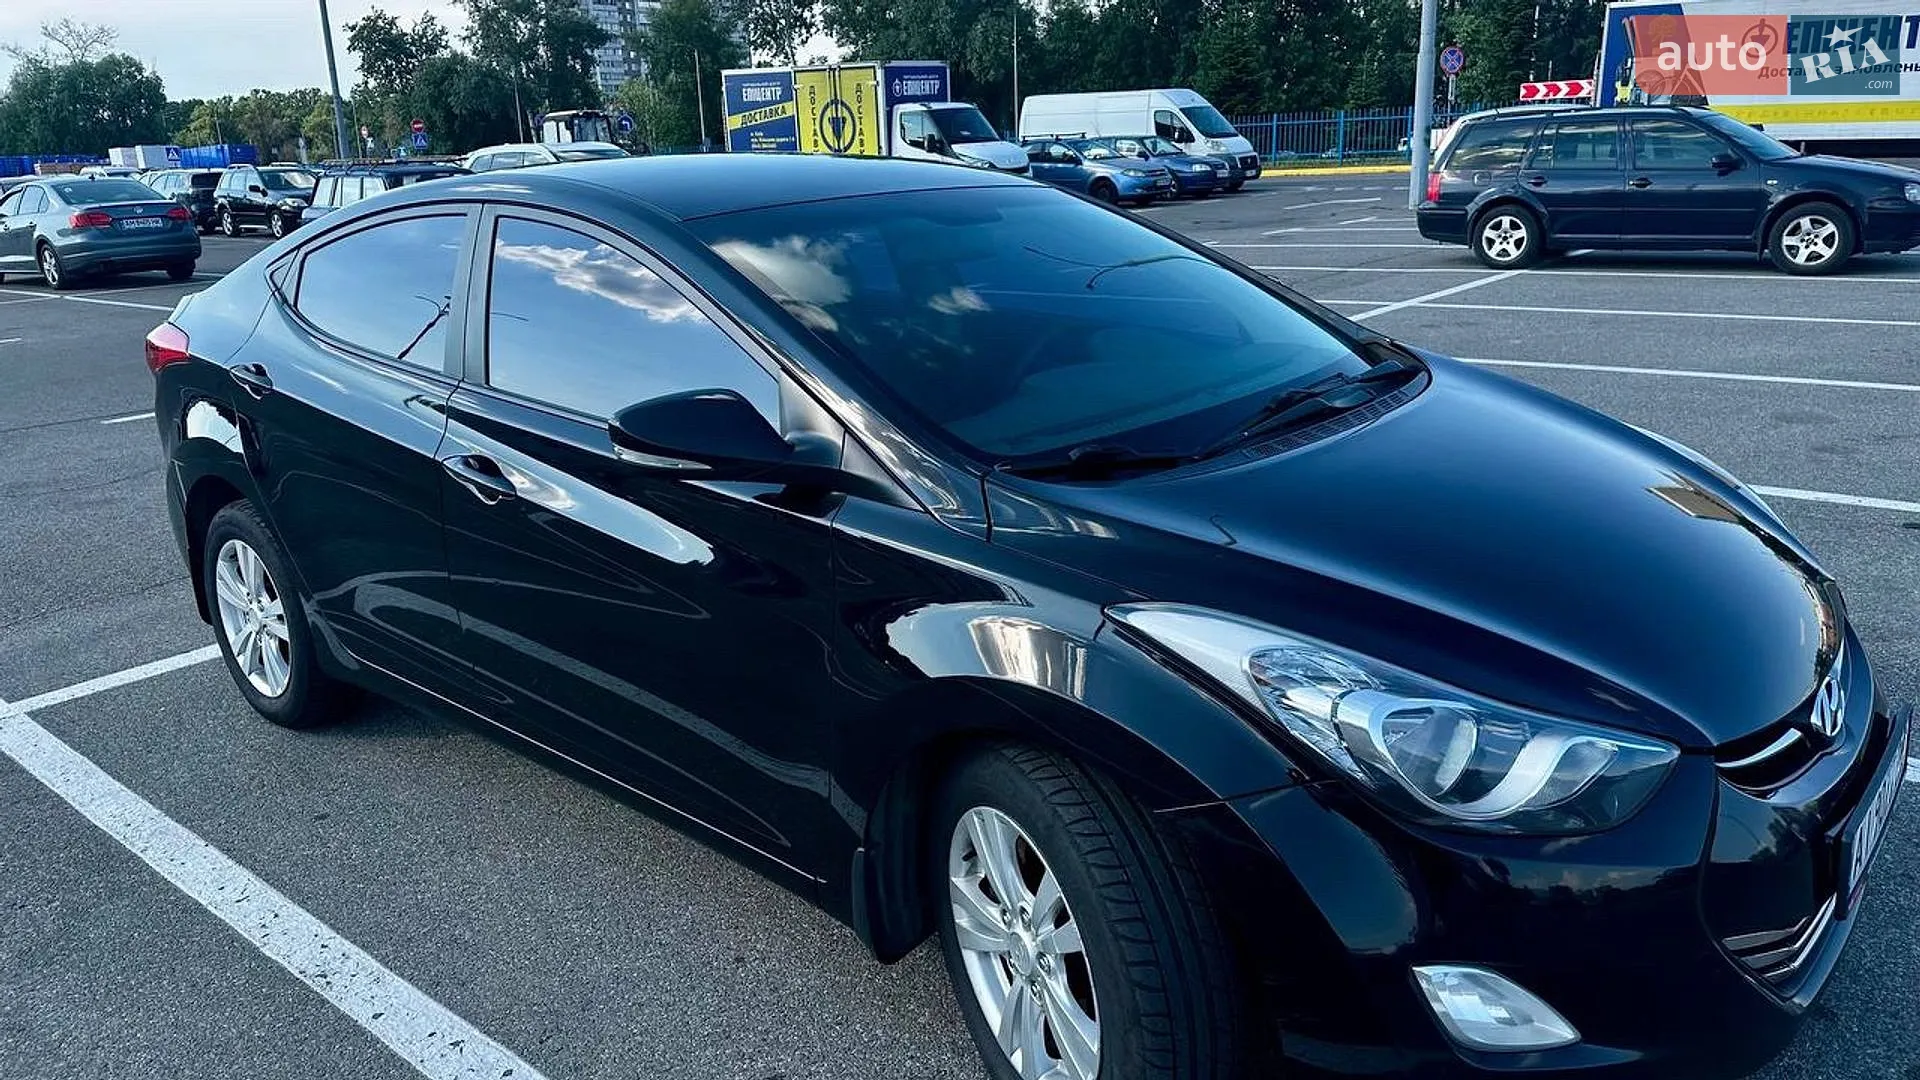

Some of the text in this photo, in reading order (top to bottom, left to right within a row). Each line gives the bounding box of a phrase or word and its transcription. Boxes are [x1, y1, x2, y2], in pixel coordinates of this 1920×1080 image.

[1758, 62, 1920, 80] Доста змовлень
[741, 105, 787, 126] ДОСТАВКА
[809, 86, 819, 152] ДОСТАВ
